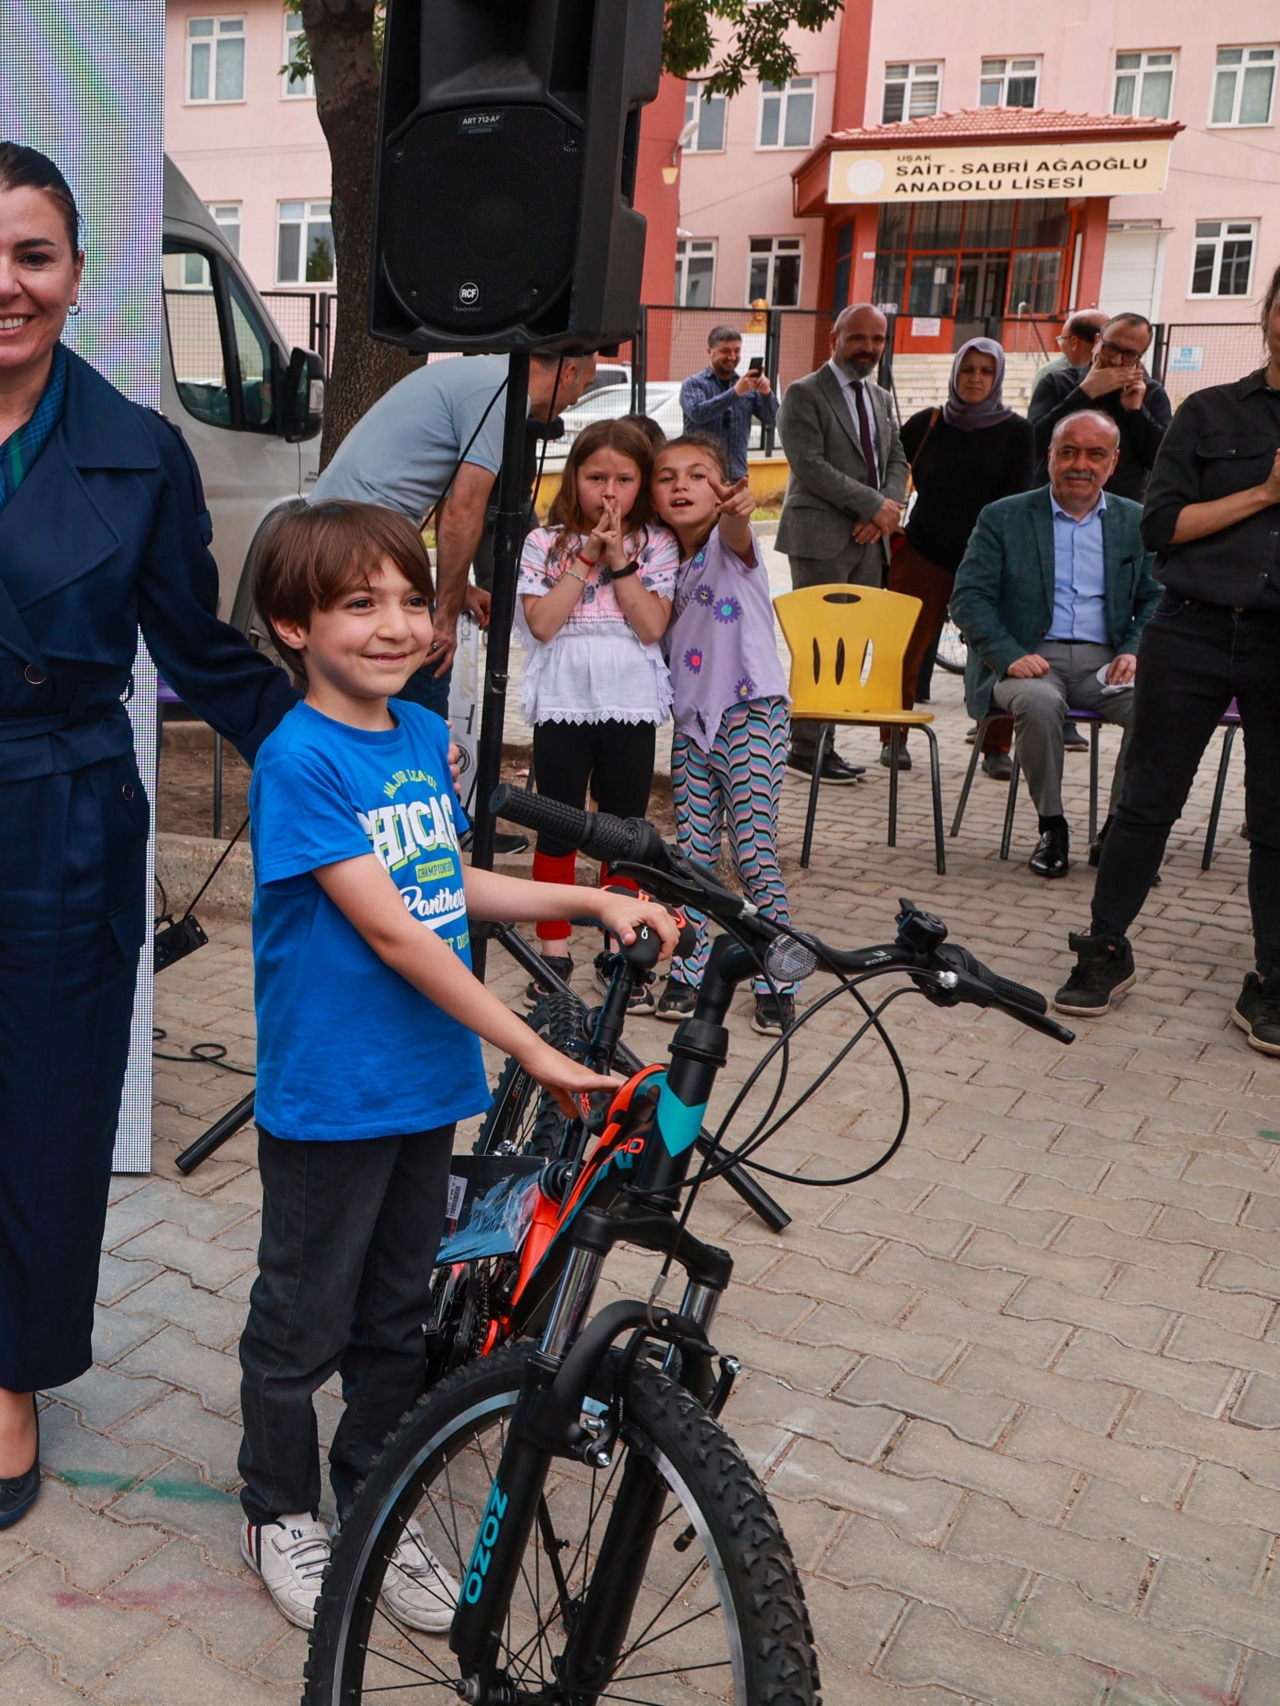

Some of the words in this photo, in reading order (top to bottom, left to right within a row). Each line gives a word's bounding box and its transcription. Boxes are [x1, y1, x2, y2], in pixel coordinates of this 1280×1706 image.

[895, 162, 945, 177] SAİT
[961, 159, 1029, 175] SABRİ
[1036, 155, 1149, 173] AĞAOĞLU
[896, 153, 933, 165] UŞAK
[894, 178, 1003, 195] ANADOLU
[1011, 173, 1084, 190] LİSESİ
[461, 288, 477, 299] RCF
[864, 955, 893, 967] ZOZO
[465, 1486, 508, 1605] ZOZO
